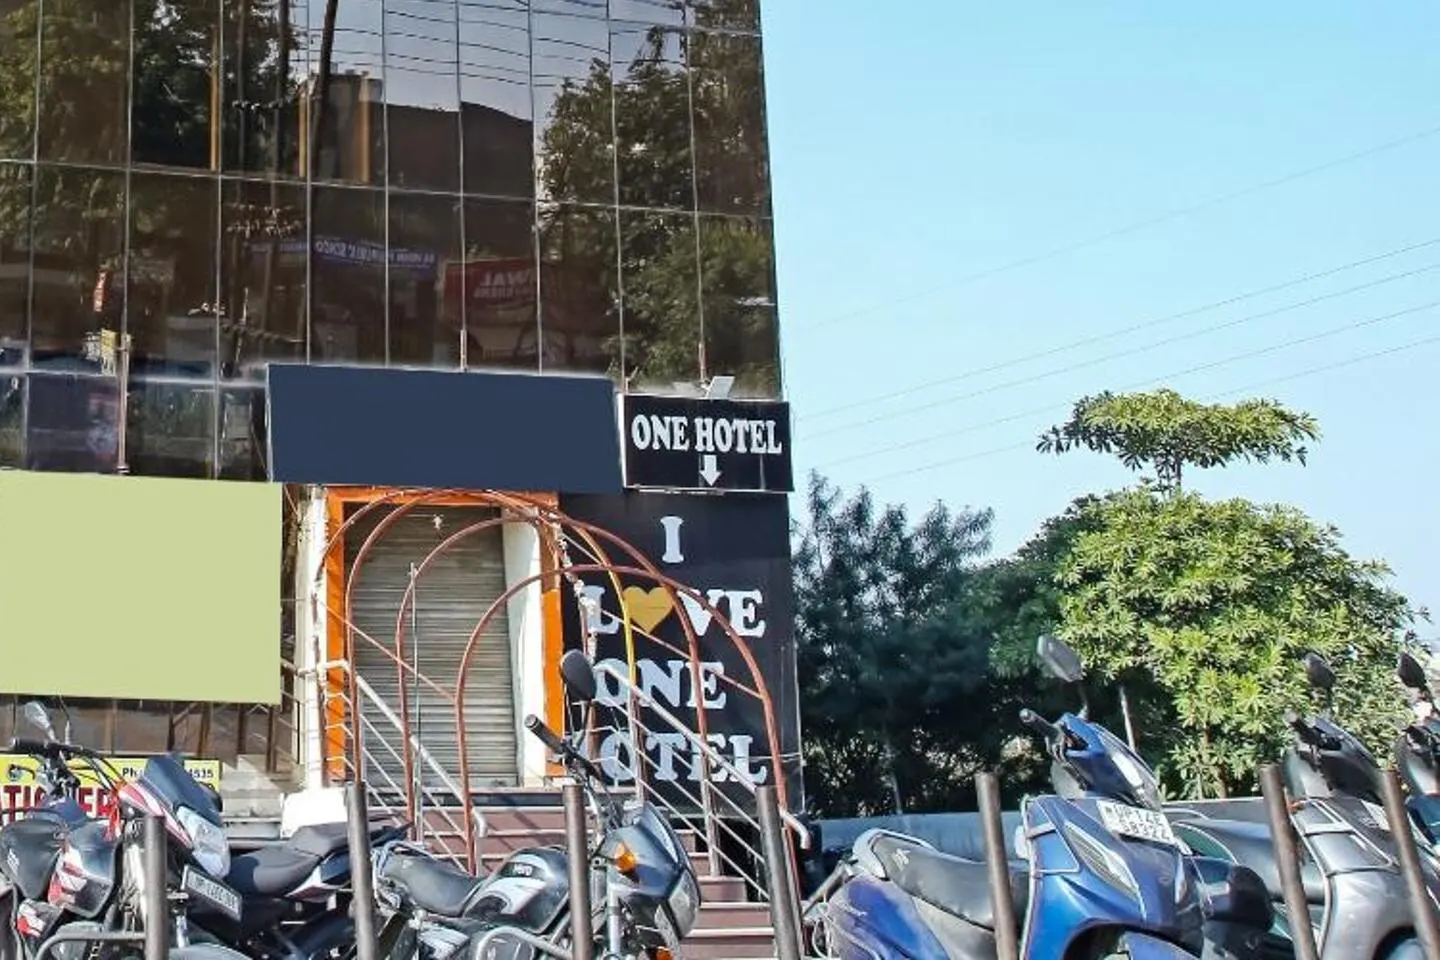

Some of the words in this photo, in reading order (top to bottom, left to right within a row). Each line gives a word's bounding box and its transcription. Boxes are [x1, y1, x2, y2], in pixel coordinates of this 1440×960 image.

[631, 414, 690, 451] ONE
[693, 417, 783, 455] HOTEL
[661, 516, 684, 564] I
[593, 658, 727, 710] ONE
[568, 729, 767, 783] OTEL
